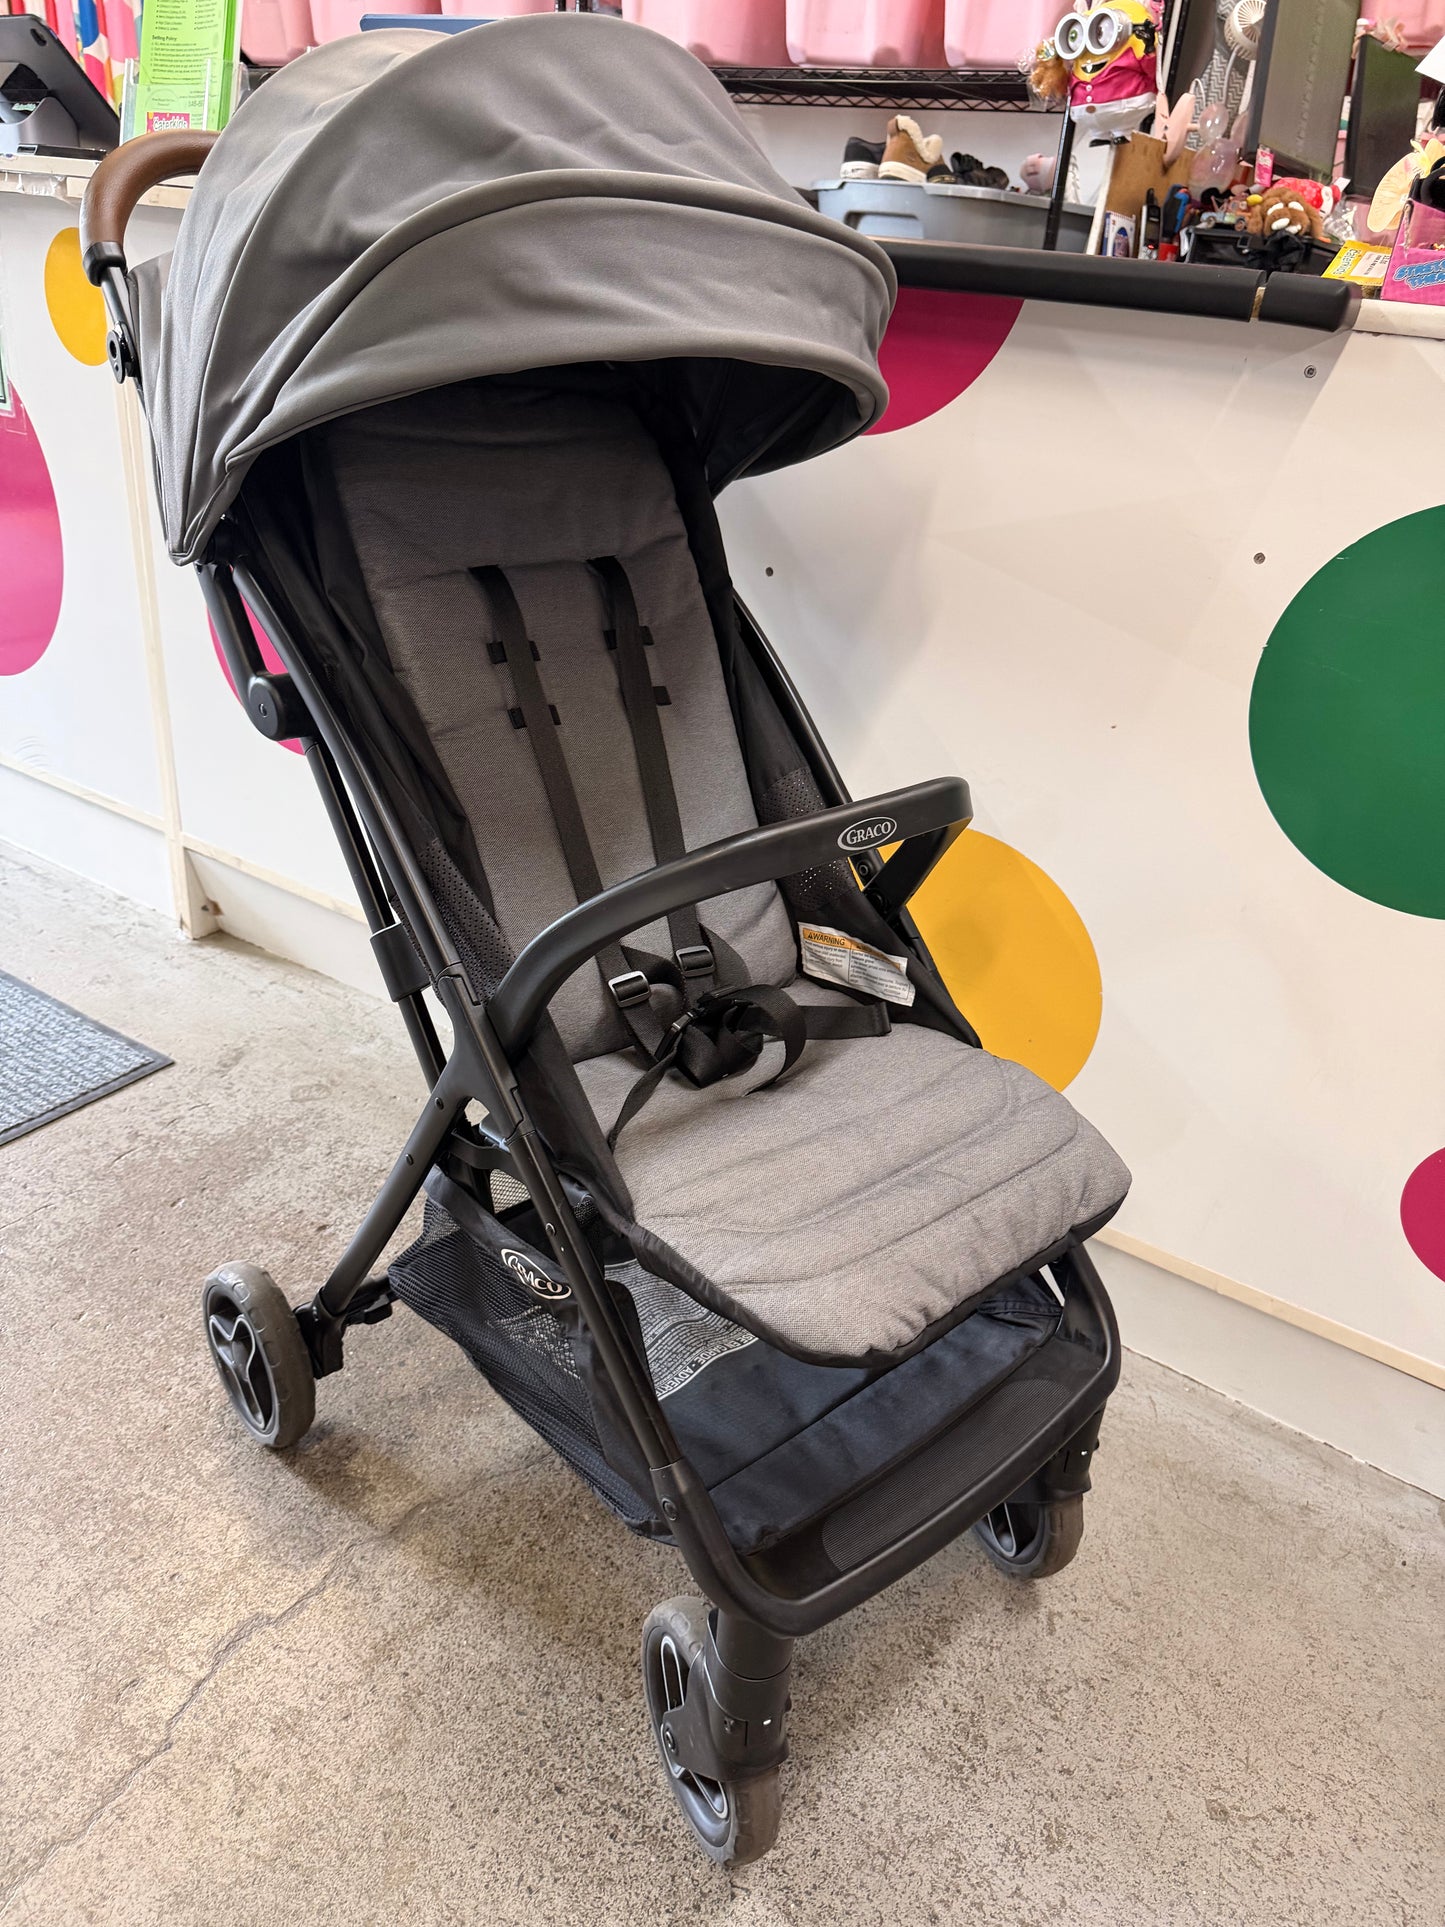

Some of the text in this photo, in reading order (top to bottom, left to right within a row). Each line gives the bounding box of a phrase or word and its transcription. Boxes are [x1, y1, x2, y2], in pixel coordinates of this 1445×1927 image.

[846, 821, 892, 845] GRACO
[812, 932, 846, 946] WARNING
[507, 1255, 564, 1293] GRACO
[693, 1344, 728, 1366] GARDE
